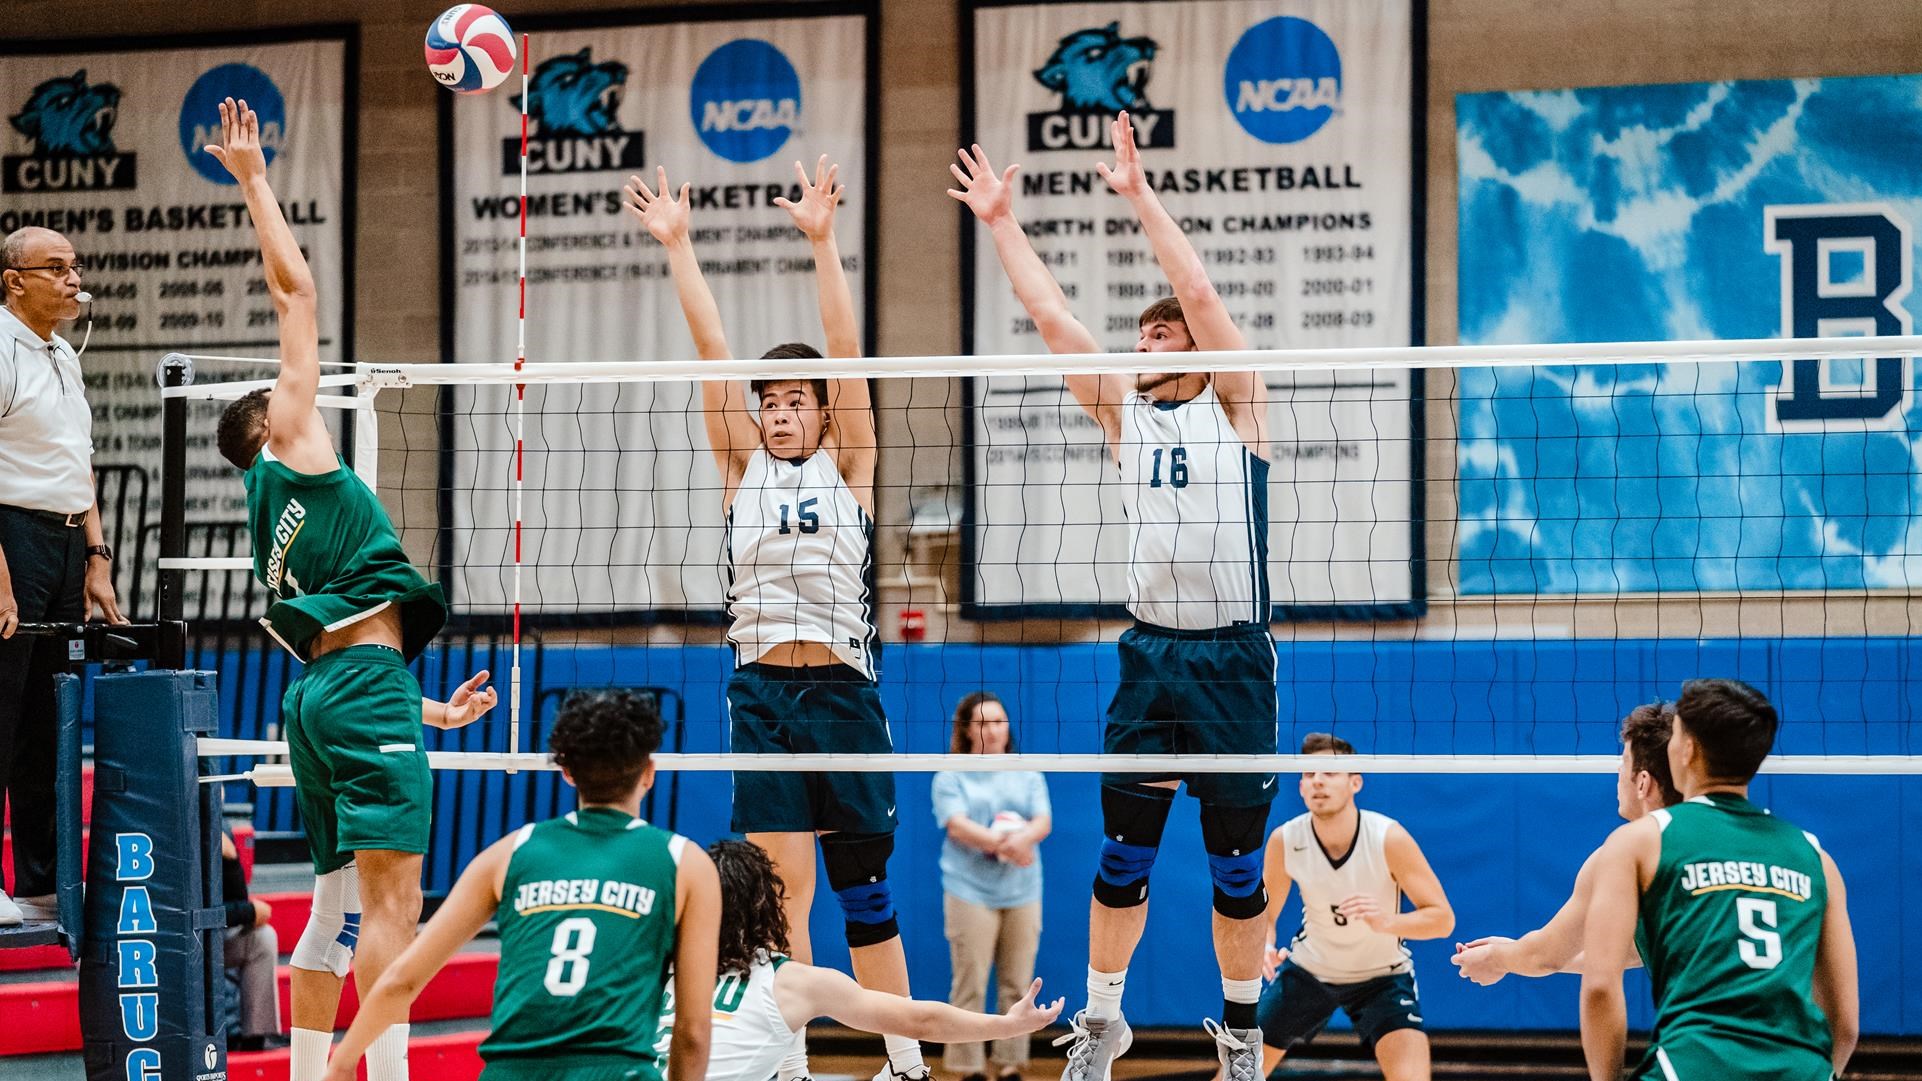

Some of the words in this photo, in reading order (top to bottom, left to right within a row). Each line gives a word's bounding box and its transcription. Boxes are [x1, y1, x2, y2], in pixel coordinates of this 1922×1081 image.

[1236, 77, 1340, 112] NCAA
[702, 98, 799, 133] NCAA
[18, 156, 120, 189] CUNY
[518, 137, 630, 171] CUNY
[472, 190, 622, 220] WOMEN'S
[1105, 217, 1213, 237] DIVON
[1223, 212, 1373, 234] CHAMPIONS
[1764, 202, 1914, 434] B
[1150, 447, 1189, 488] 16
[275, 498, 306, 545] CITY
[778, 497, 820, 535] 15
[514, 879, 599, 912] JERSEY
[600, 883, 656, 916] CITY
[1681, 861, 1766, 891] JERSEY
[1770, 866, 1812, 900] CITY
[1736, 897, 1783, 969] 5
[543, 917, 597, 996] 8
